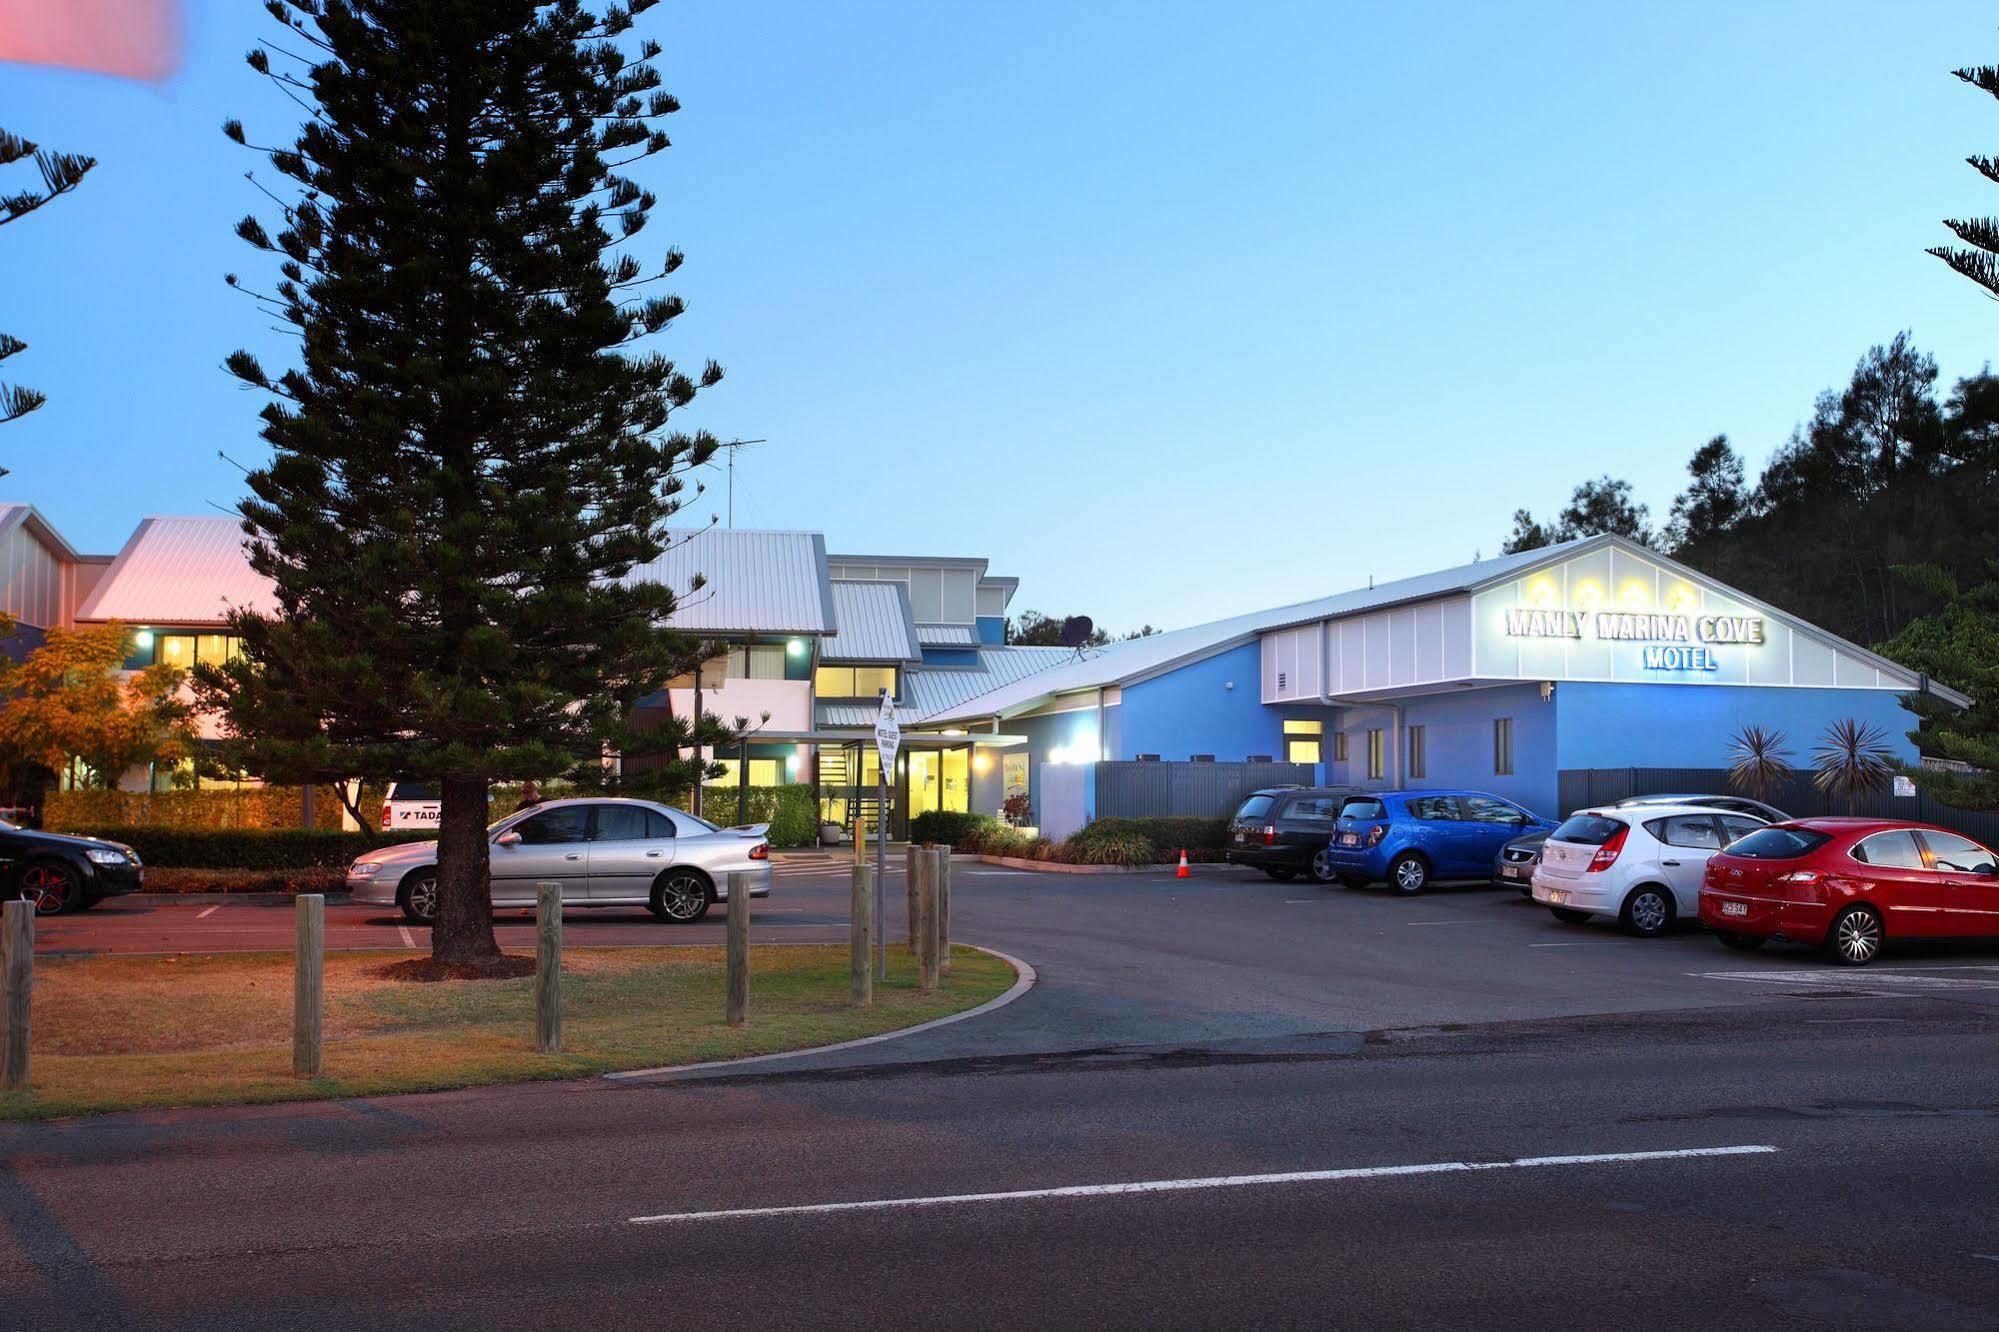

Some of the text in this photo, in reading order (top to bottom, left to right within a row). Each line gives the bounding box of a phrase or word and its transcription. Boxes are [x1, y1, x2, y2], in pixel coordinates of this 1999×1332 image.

[1506, 609, 1765, 645] MANLY MARINA COVE
[1644, 646, 1717, 671] MOTEL
